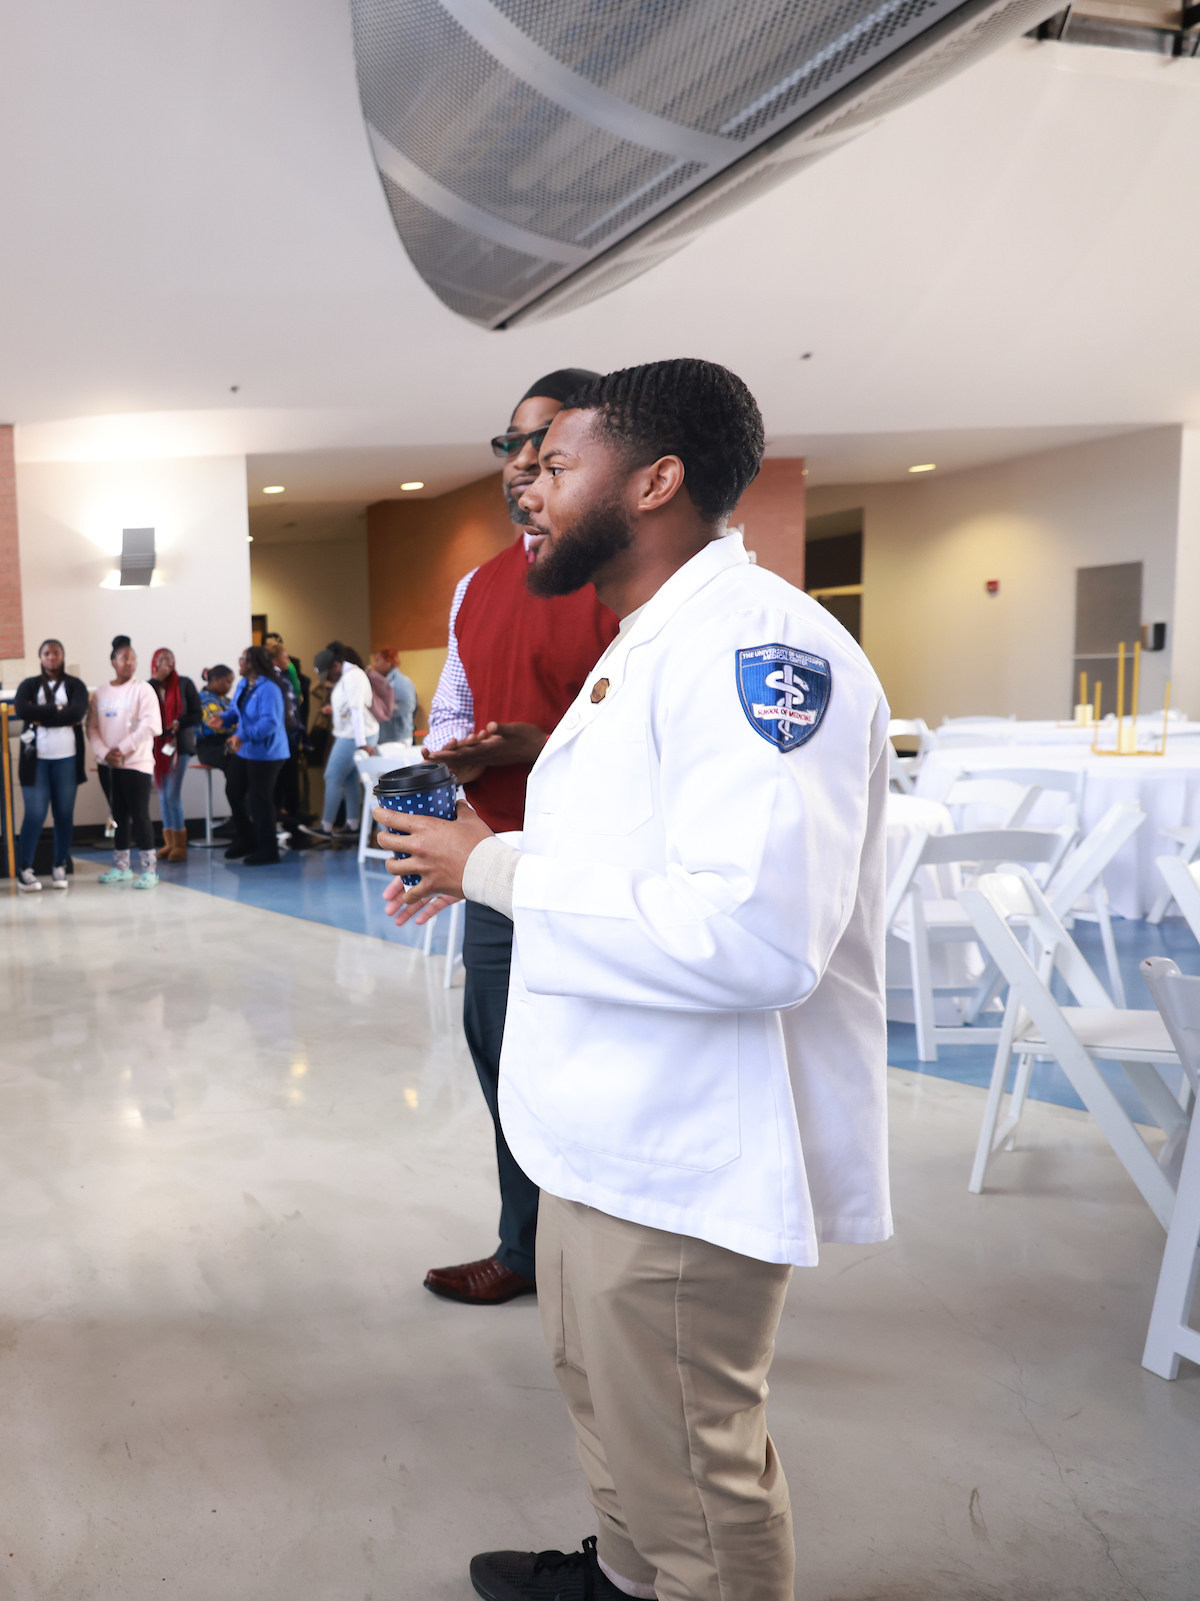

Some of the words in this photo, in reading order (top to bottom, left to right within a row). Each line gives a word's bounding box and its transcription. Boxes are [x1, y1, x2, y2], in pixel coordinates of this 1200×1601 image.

[742, 651, 754, 659] THE
[755, 648, 788, 657] UNIVERSITY
[789, 710, 811, 721] MEDICINE
